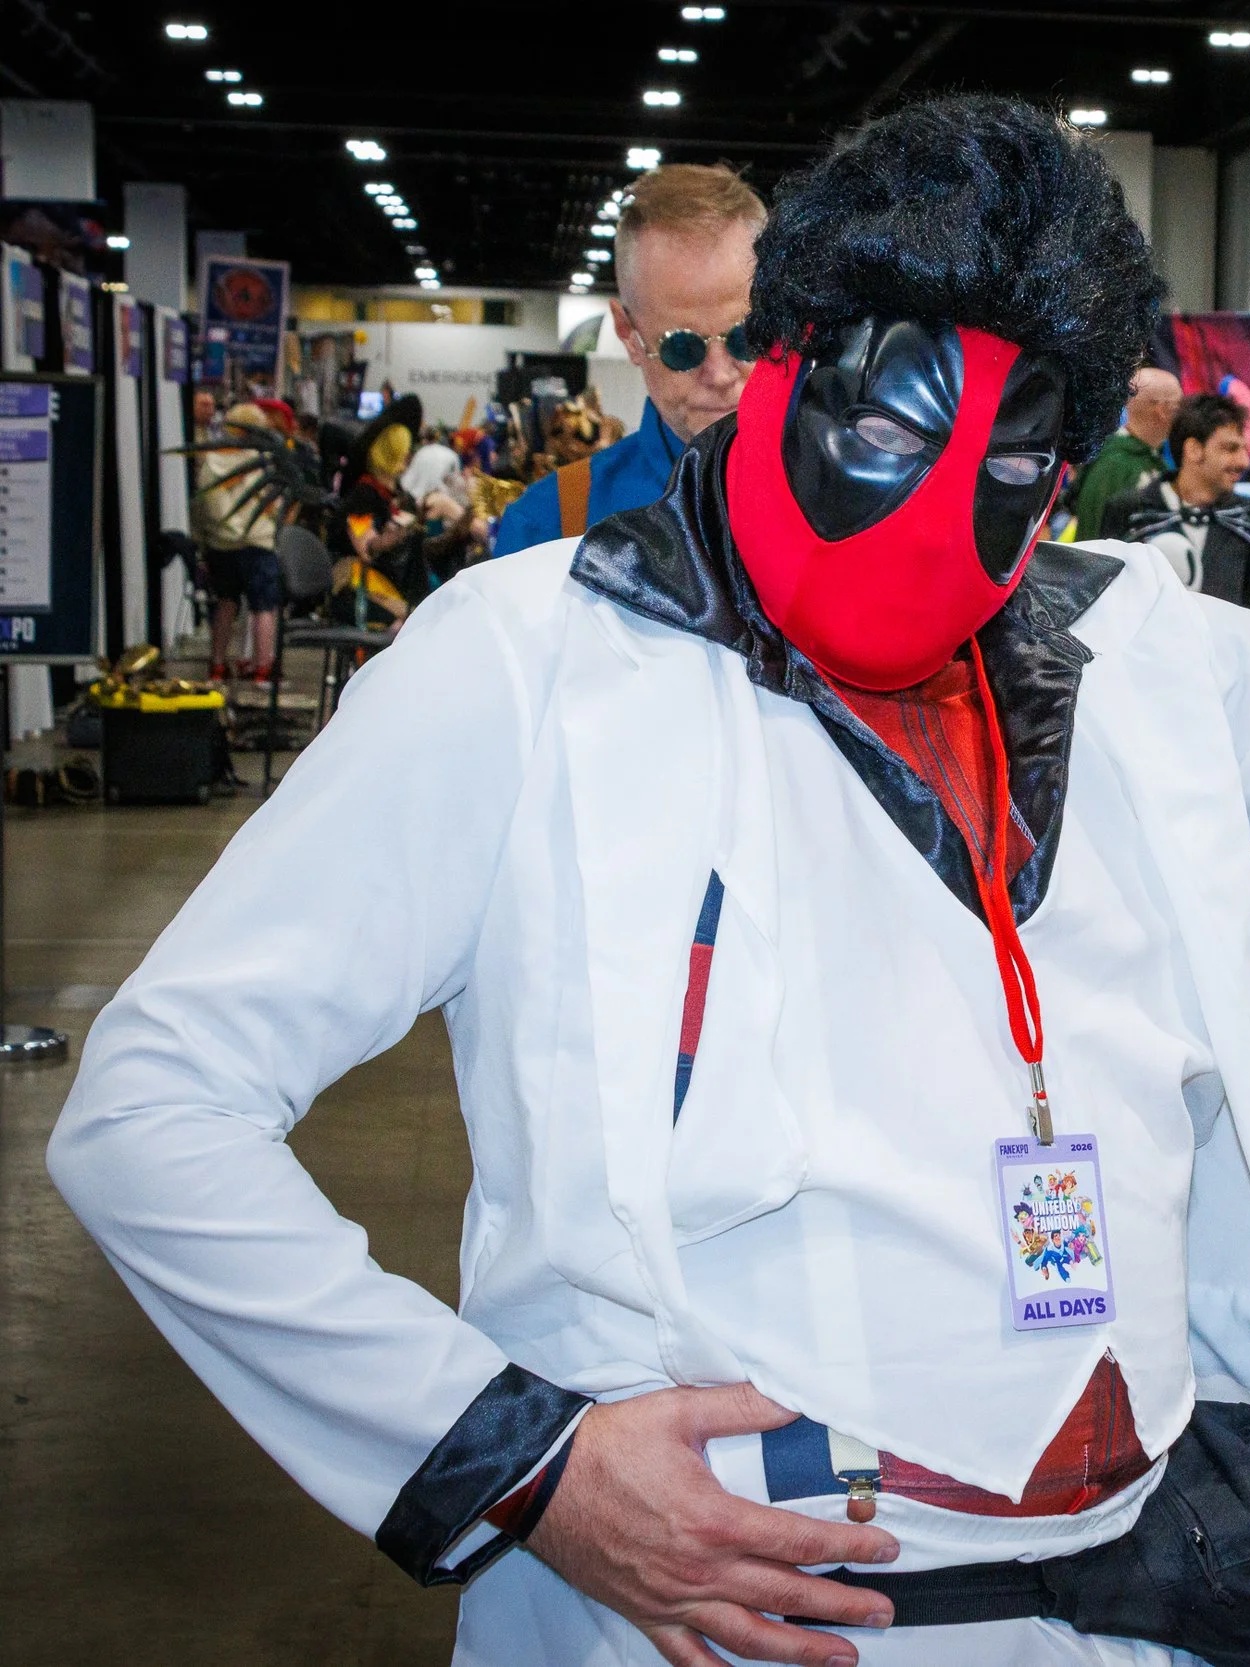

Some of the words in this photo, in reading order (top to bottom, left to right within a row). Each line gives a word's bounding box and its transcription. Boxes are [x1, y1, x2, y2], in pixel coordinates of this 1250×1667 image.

[1070, 1143, 1093, 1152] 2026
[1032, 1200, 1065, 1216] UNITED
[1066, 1199, 1080, 1214] BY
[1033, 1213, 1080, 1232] FANDOM
[1023, 1301, 1056, 1321] ALL
[1059, 1296, 1107, 1317] DAYS
